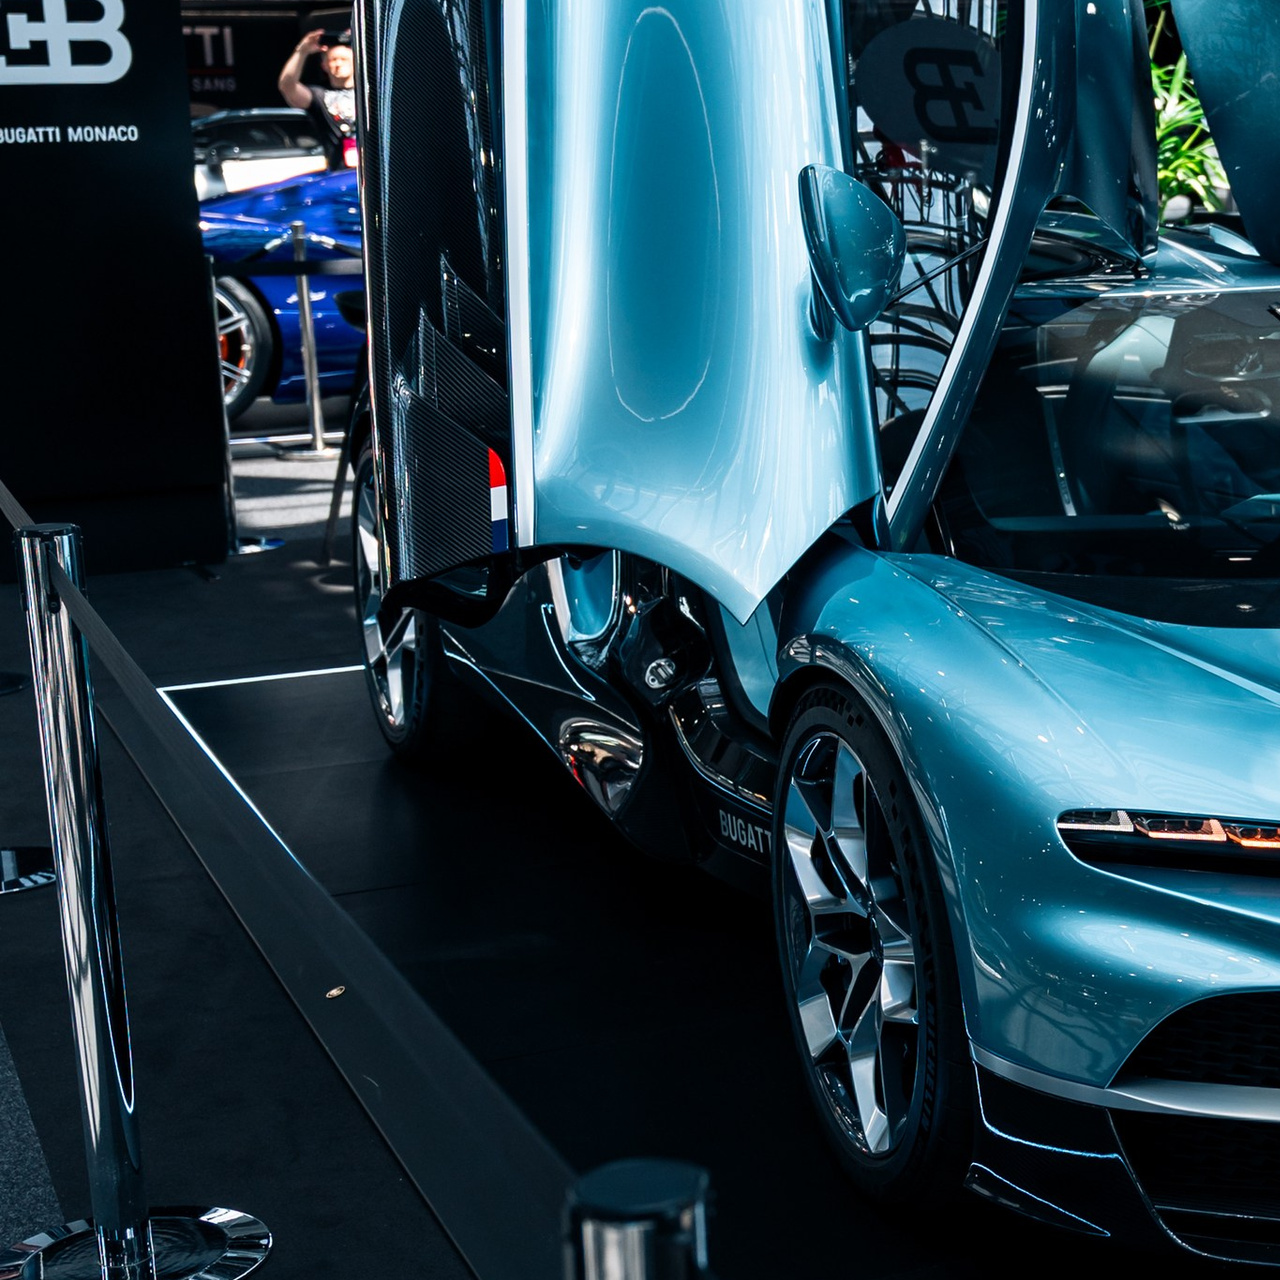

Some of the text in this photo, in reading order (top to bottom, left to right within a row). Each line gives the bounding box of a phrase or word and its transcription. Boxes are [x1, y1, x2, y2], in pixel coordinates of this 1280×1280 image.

[191, 75, 237, 93] SANG
[67, 124, 139, 143] MONACO
[718, 808, 773, 856] BUGATT
[919, 1001, 937, 1133] MICHELIN
